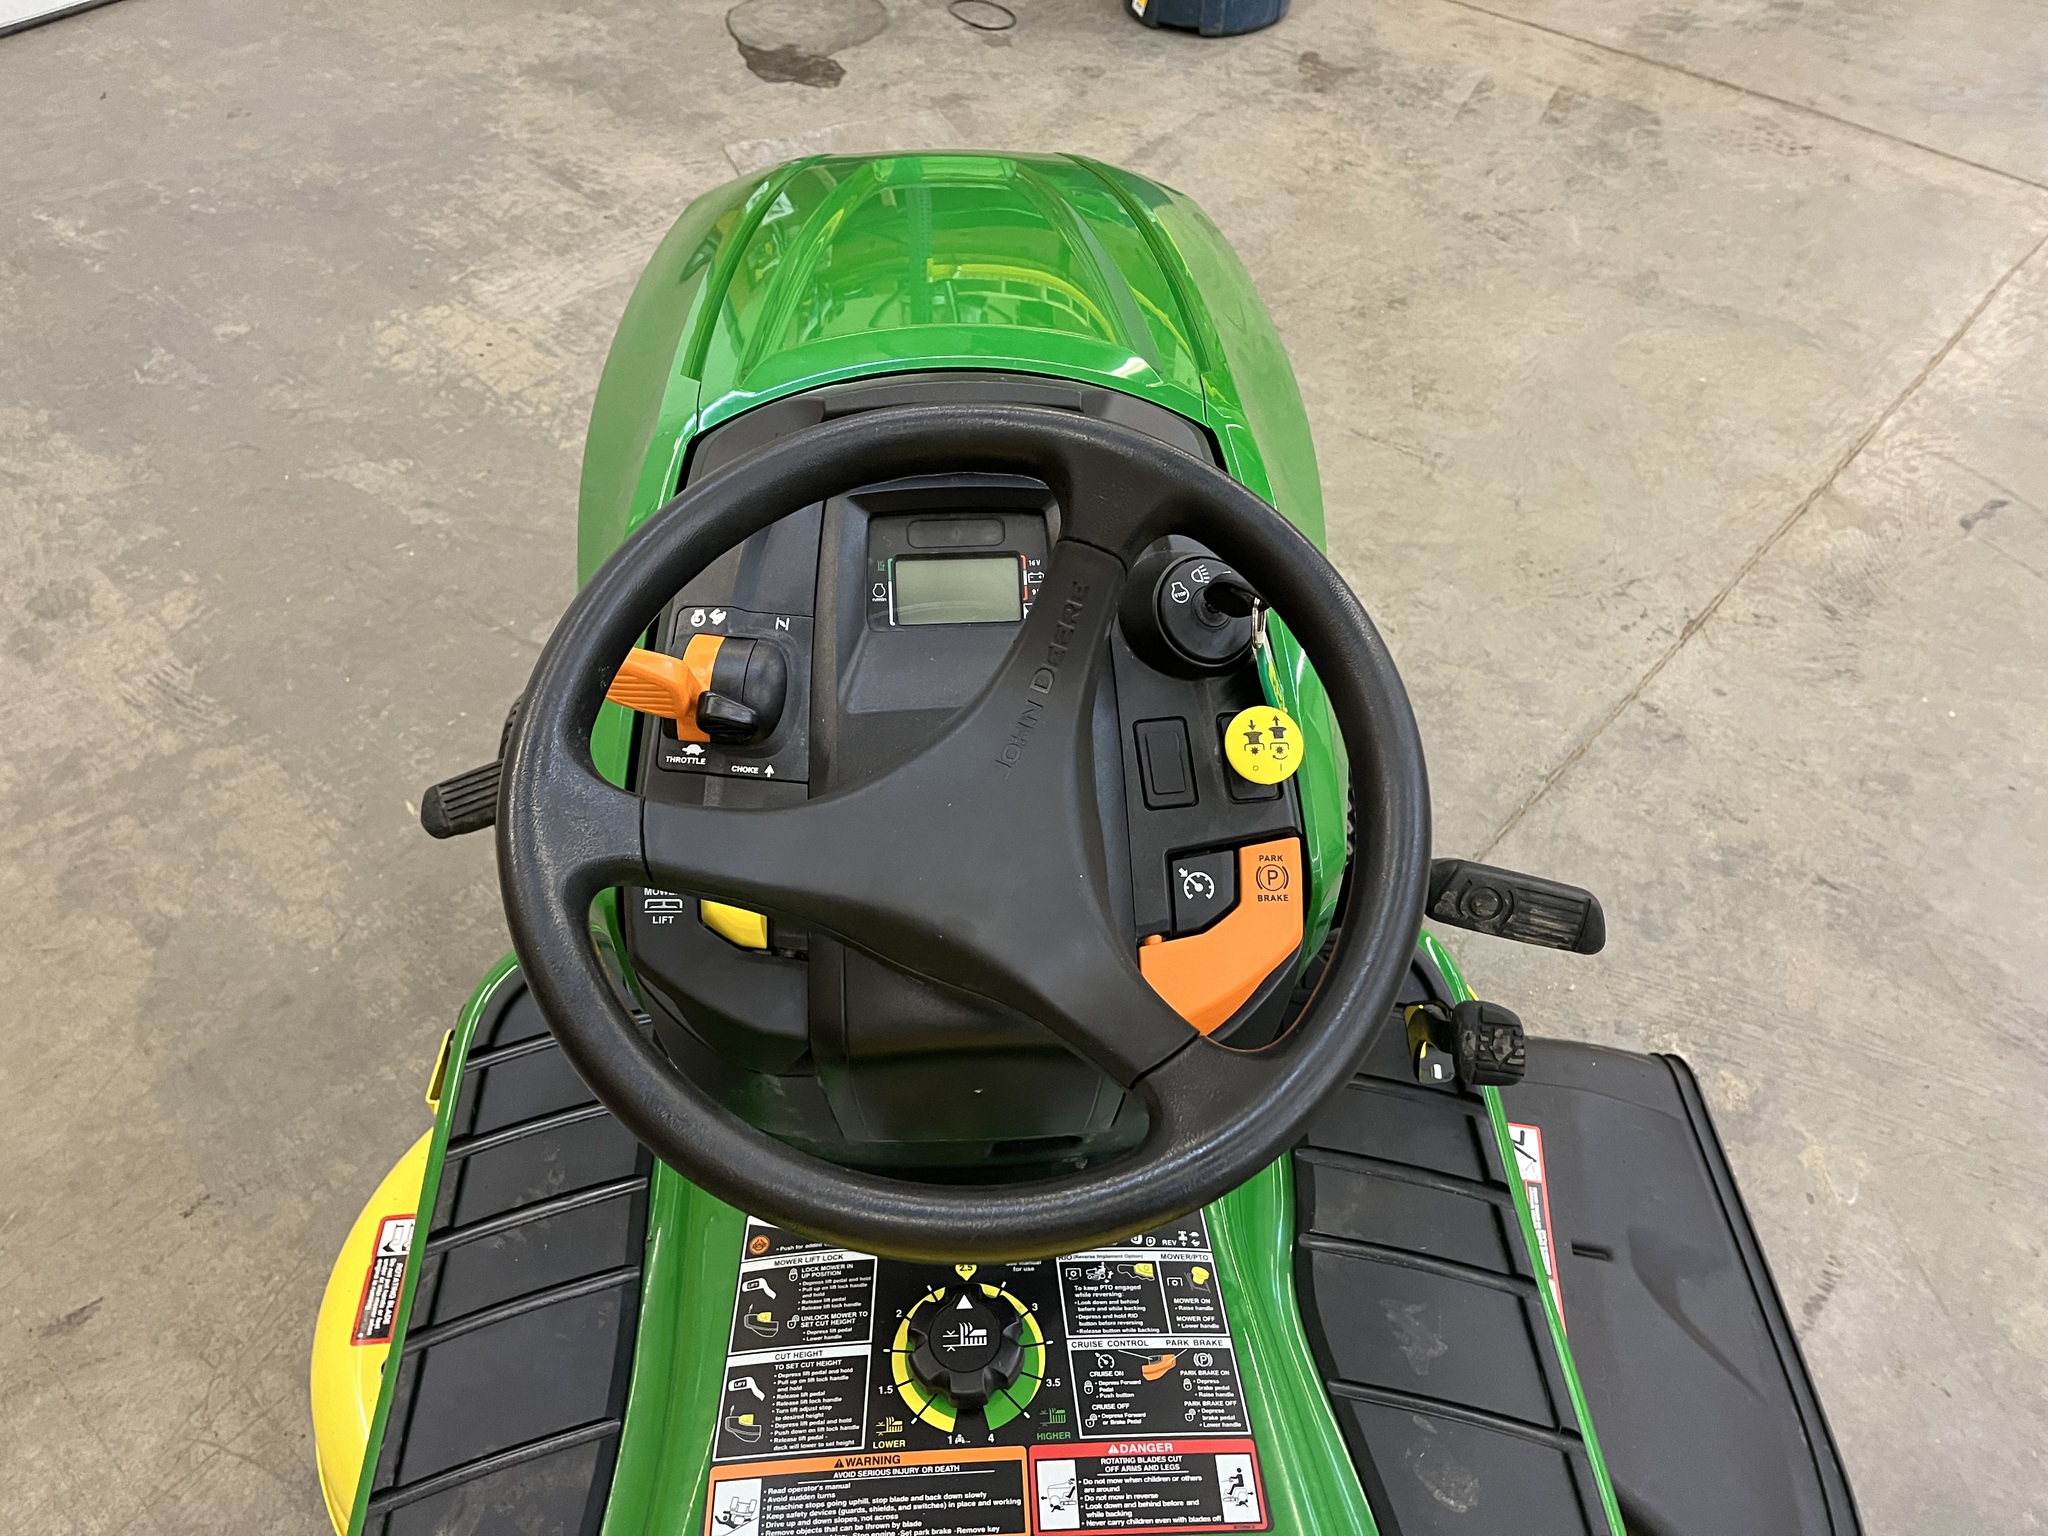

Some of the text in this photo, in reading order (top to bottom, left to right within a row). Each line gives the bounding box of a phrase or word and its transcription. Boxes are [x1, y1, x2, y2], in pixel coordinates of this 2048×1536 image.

[994, 581, 1090, 781] JOHN DEERE
[666, 756, 706, 764] THROTTLE
[731, 765, 759, 773] CHOKE
[879, 1386, 893, 1394] 1.5
[988, 1434, 994, 1442] 4
[873, 1440, 906, 1449] LOWER
[1120, 1443, 1174, 1453] DANGER
[846, 1455, 900, 1467] WARNING
[1101, 1457, 1135, 1465] ROTATING
[858, 1469, 891, 1478] SERIOUS
[788, 1485, 823, 1493] operator's
[827, 1499, 846, 1508] going
[964, 1491, 987, 1500] slowly
[786, 1511, 808, 1519] safety
[810, 1509, 836, 1517] devices
[913, 1502, 947, 1510] switches)
[957, 1501, 976, 1509] place
[796, 1527, 823, 1536] objects
